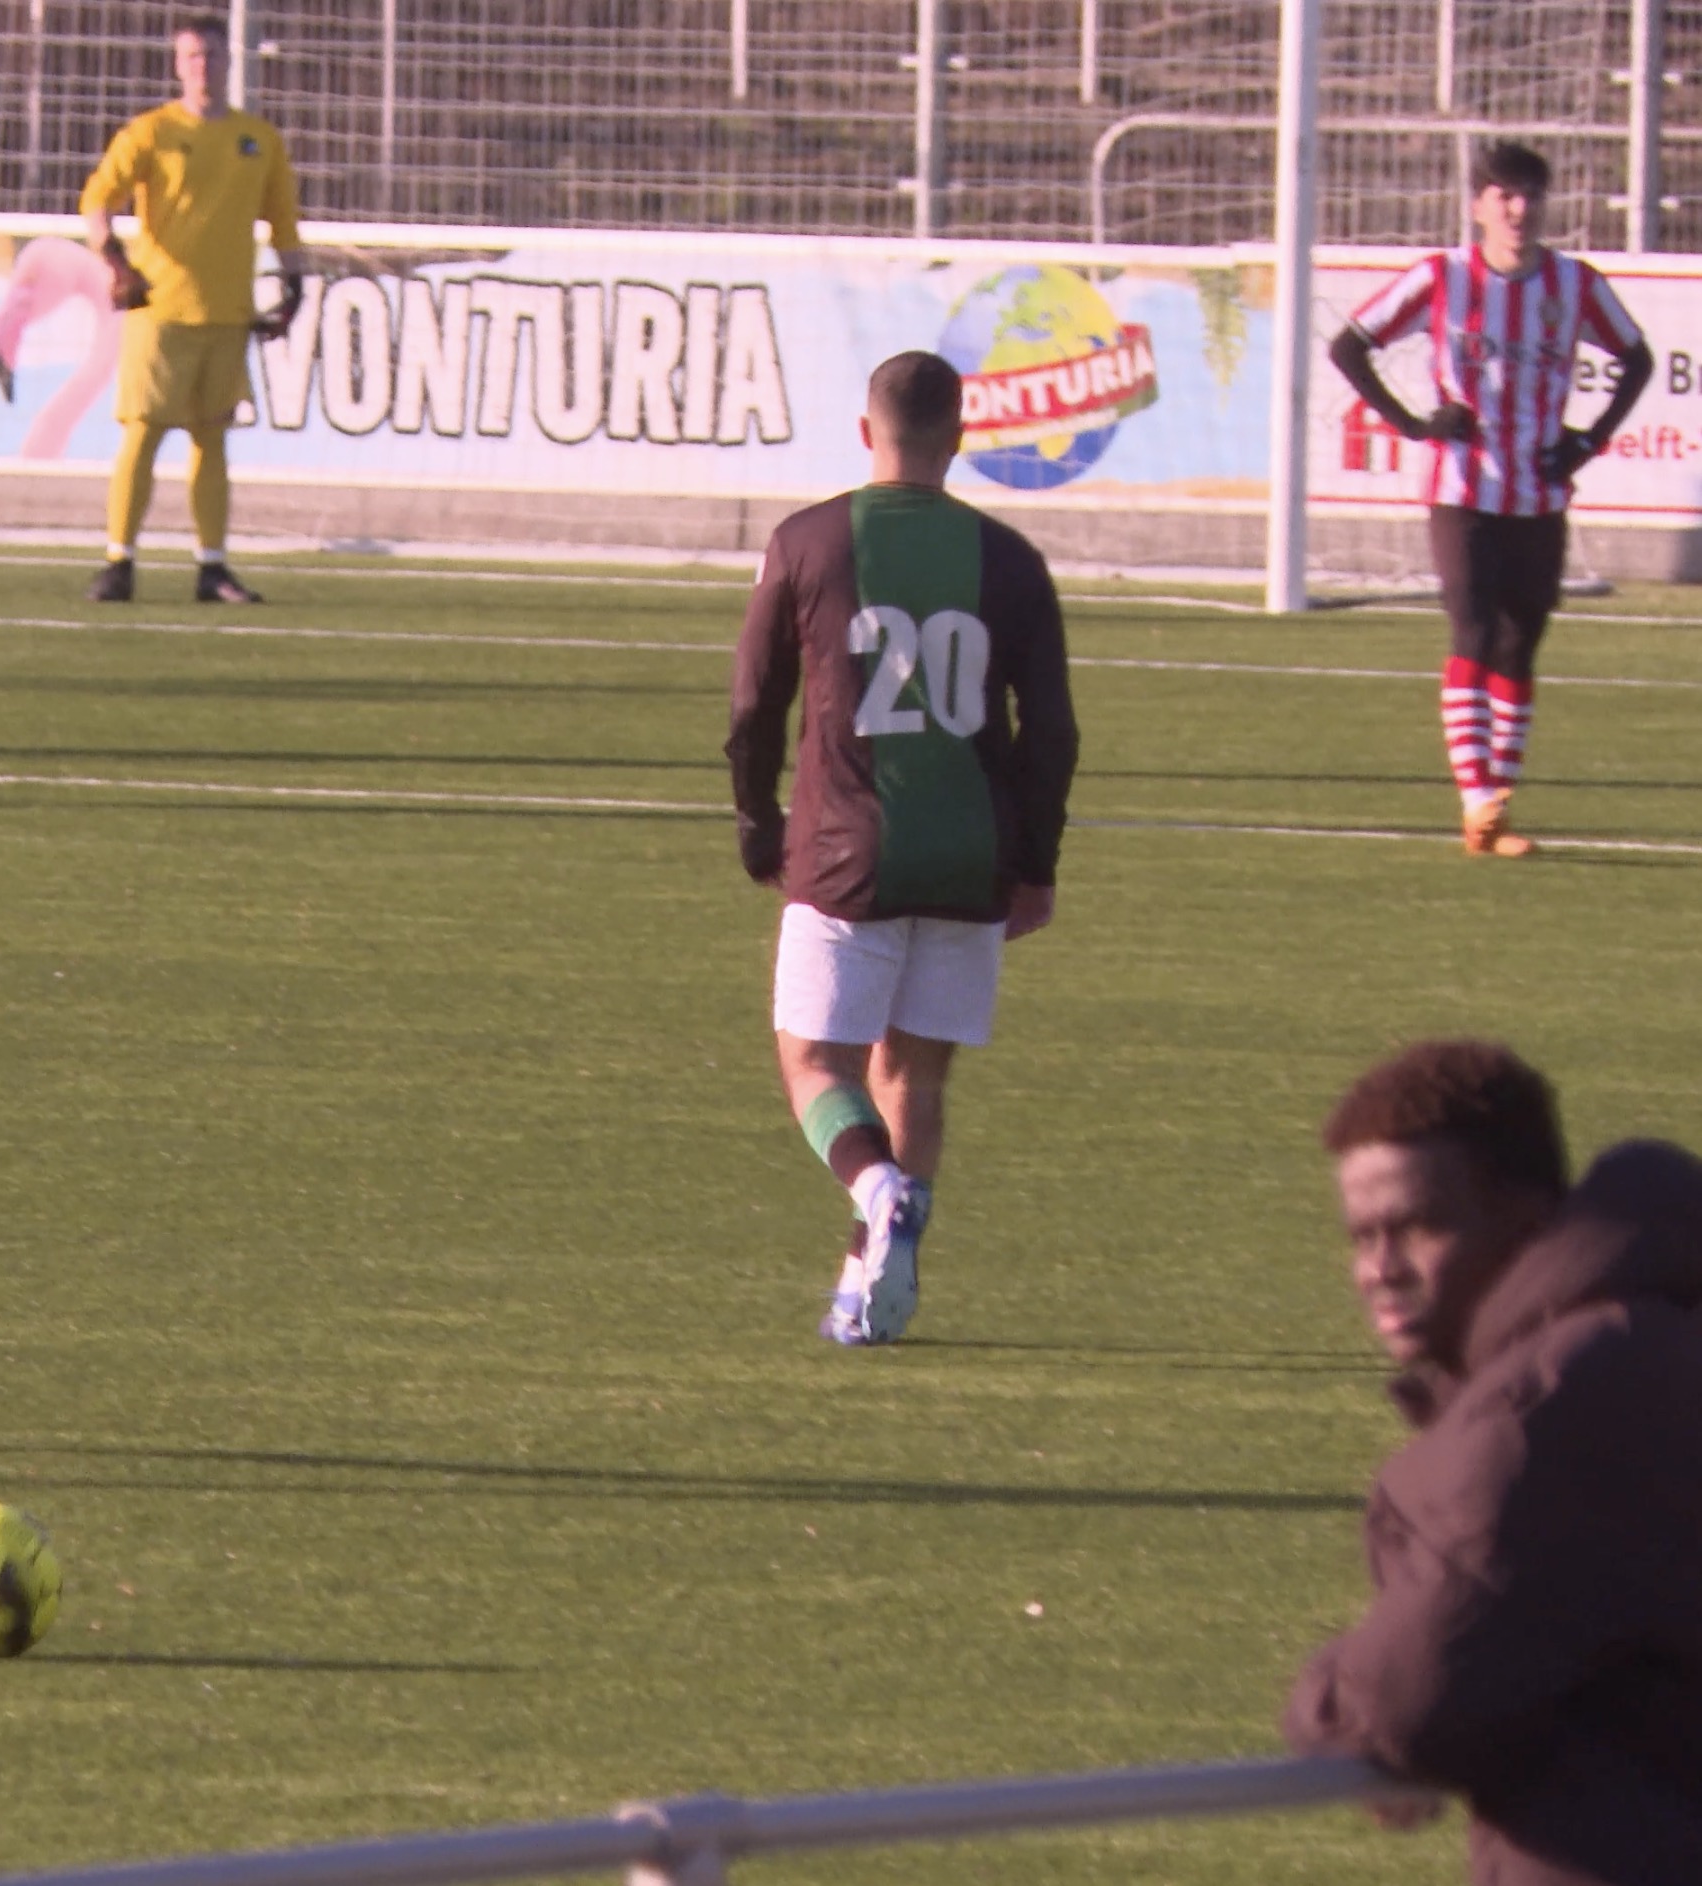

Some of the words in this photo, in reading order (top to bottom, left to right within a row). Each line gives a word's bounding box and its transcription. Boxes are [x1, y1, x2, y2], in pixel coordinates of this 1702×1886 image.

[233, 273, 791, 444] VONTURIA
[960, 340, 1155, 425] ONTURIA
[848, 605, 992, 738] 20
